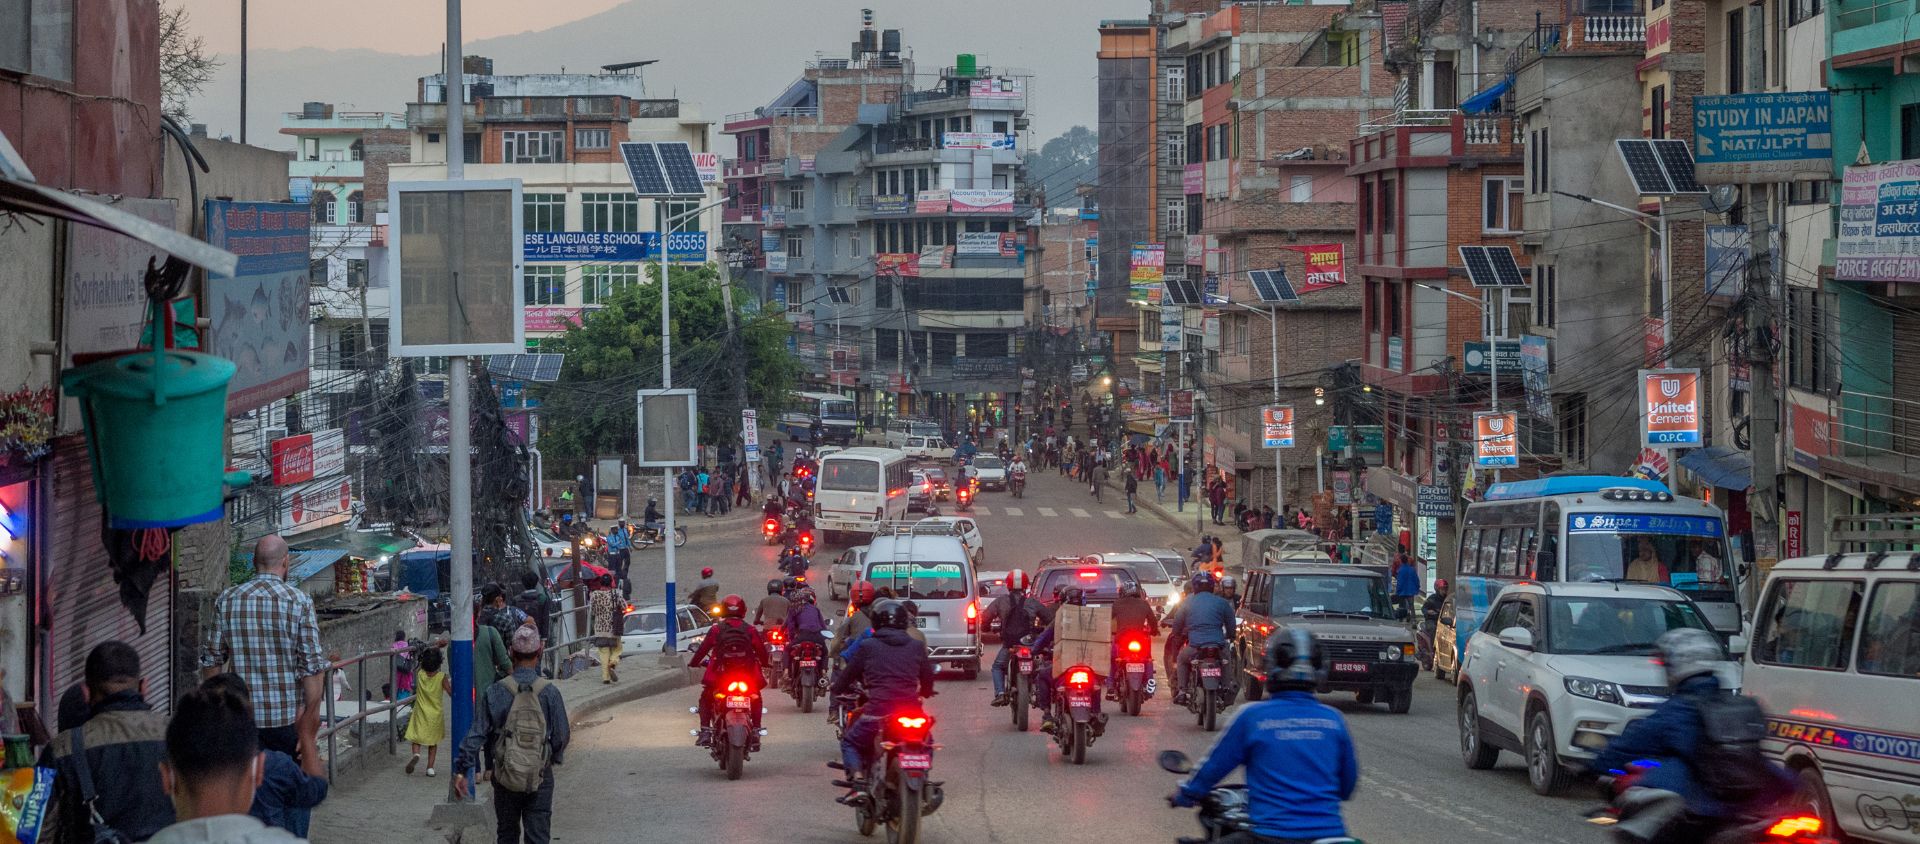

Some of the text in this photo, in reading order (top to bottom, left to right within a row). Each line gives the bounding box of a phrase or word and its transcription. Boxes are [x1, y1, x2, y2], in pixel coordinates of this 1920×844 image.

[1697, 105, 1828, 128] STUDY IN JAPAN
[1763, 127, 1806, 136] Language
[1721, 137, 1805, 151] NAT/JLPT
[1724, 150, 1770, 161] Preparation
[952, 190, 1014, 198] Accounting Training
[547, 233, 600, 245] LANGUAGE
[603, 233, 643, 245] SCHOOL
[1310, 252, 1339, 266] भाषा
[1836, 259, 1868, 278] FORCE
[1307, 271, 1340, 284] भाषा
[1648, 400, 1695, 414] United
[1648, 413, 1695, 424] Cements
[1659, 433, 1686, 442] O.P.C.
[1590, 515, 1640, 531] Super
[875, 565, 957, 574] TOURIST ONLY
